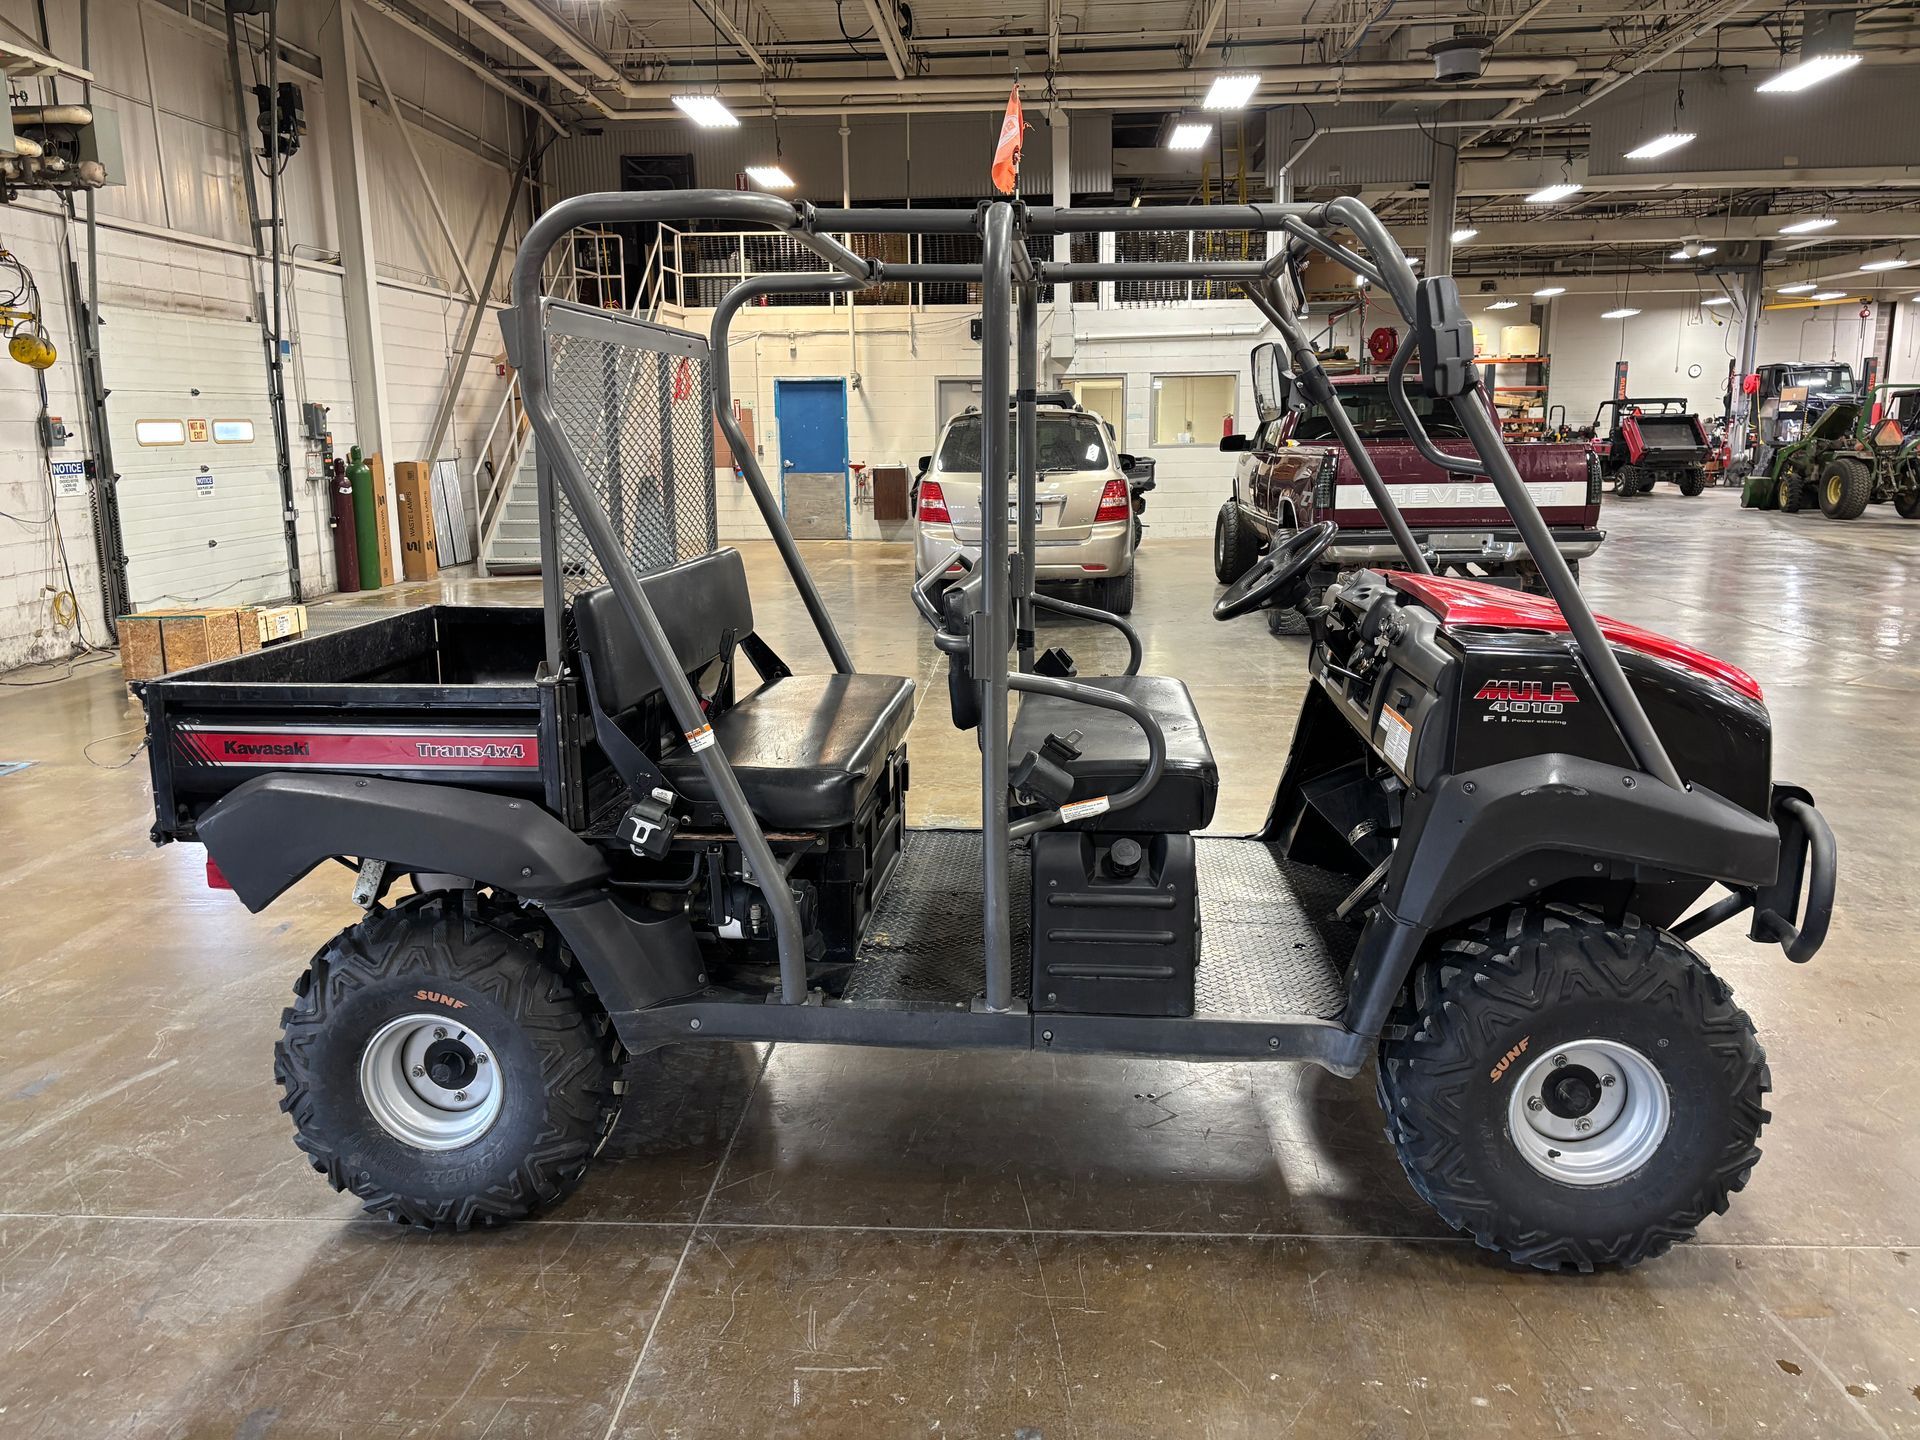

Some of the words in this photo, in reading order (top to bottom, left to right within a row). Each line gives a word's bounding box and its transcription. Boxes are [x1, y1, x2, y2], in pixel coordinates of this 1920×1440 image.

[194, 431, 203, 439] EXIT
[53, 463, 82, 474] NOTICE
[405, 490, 413, 513] LAMPS
[408, 514, 416, 538] WASTE
[1473, 680, 1580, 702] MULE
[1488, 701, 1564, 714] 4010
[223, 740, 310, 756] Kawasaki
[416, 742, 526, 759] Trans4x4
[413, 990, 469, 1009] SUNF
[1490, 1035, 1530, 1083] SUNF
